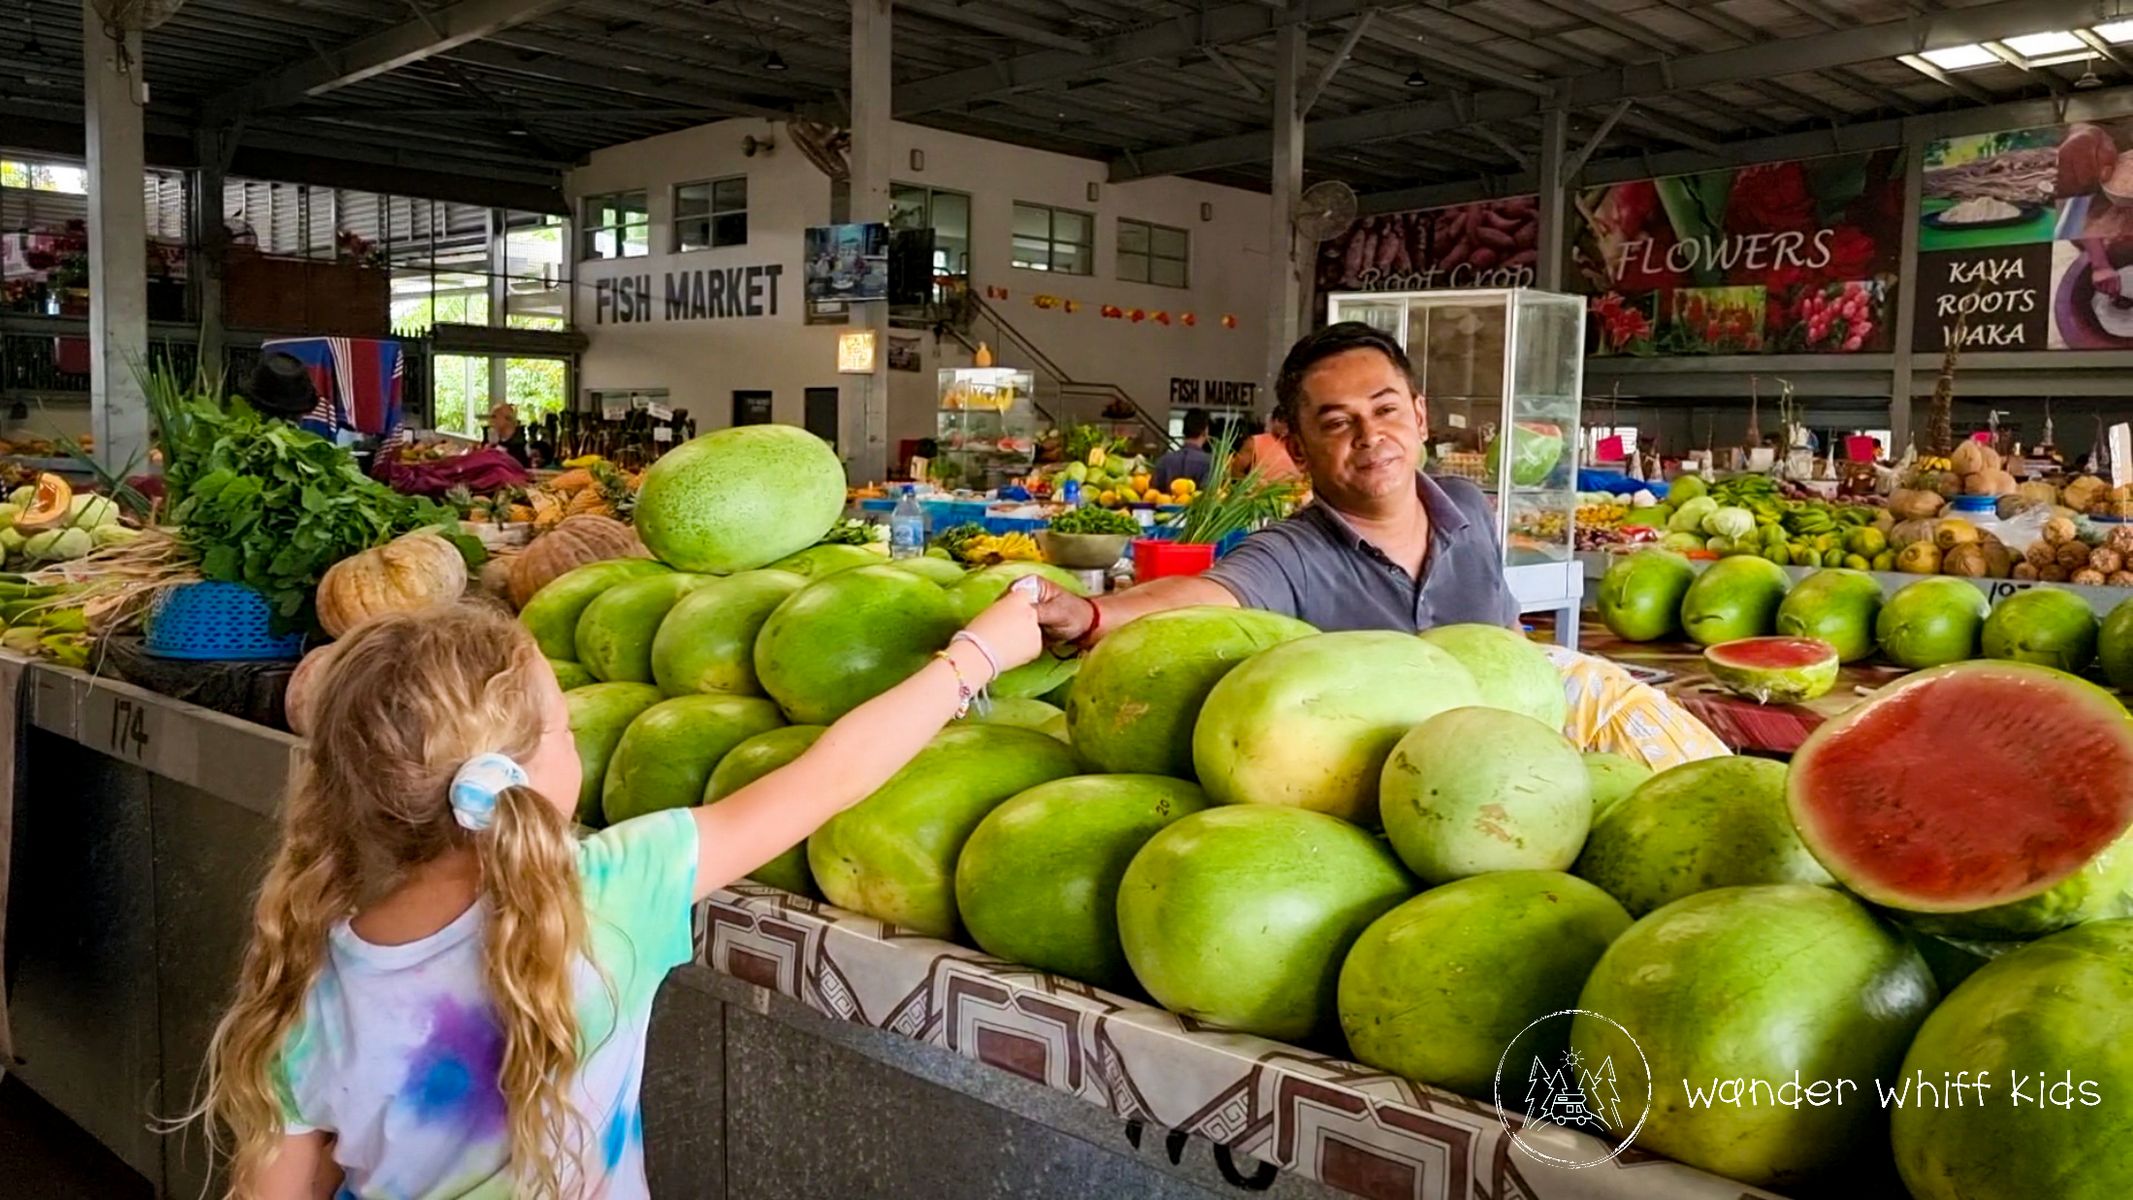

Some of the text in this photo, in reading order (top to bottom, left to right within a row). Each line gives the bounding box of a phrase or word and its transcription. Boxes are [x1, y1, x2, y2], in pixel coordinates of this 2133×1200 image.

[1617, 229, 1834, 281] FLOWERS
[1359, 264, 1445, 292] Root
[1949, 258, 2025, 285] KAVA
[596, 264, 783, 324] FISH MARKET
[1937, 289, 2036, 317] ROOTS
[1170, 377, 1256, 406] FISH MARKET
[111, 697, 149, 760] 174
